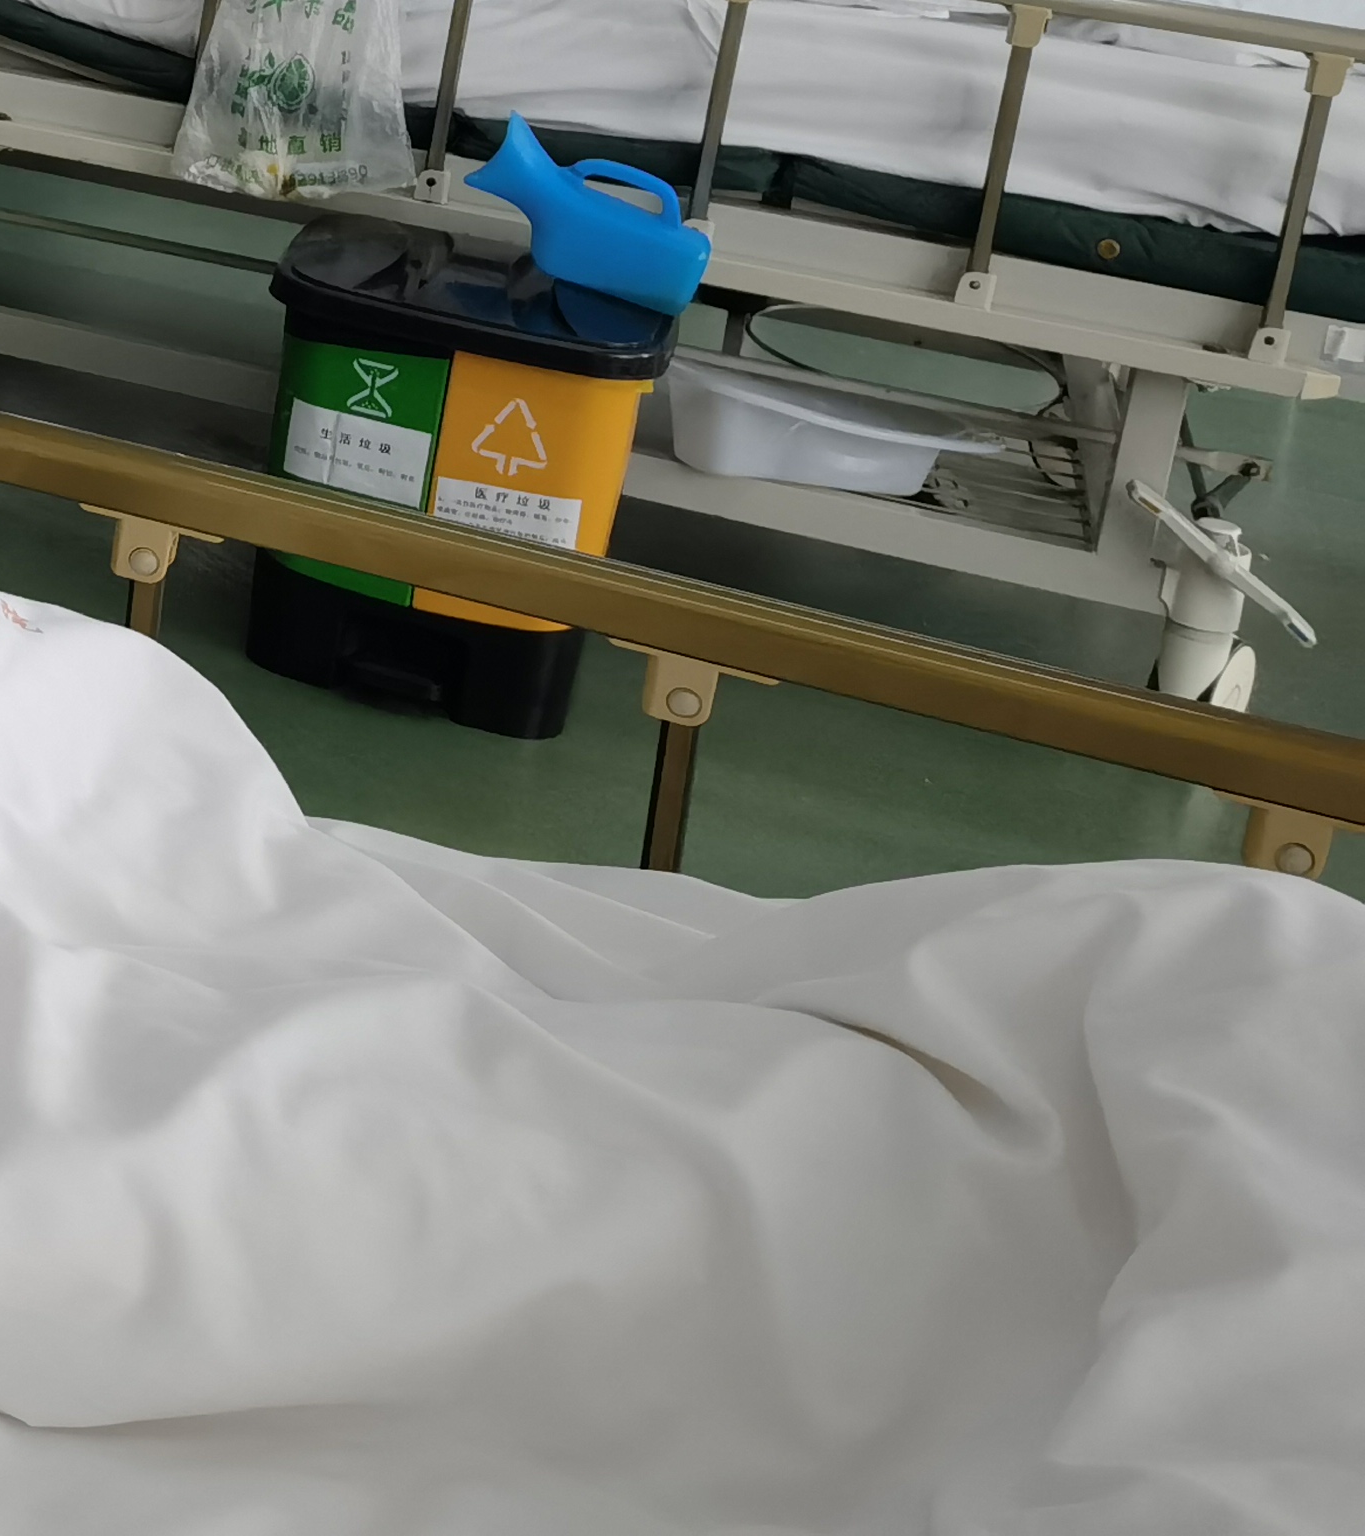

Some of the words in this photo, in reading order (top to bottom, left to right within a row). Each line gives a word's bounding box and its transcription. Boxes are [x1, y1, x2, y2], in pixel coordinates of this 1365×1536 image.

[320, 427, 392, 455] 生活垃圾
[474, 486, 551, 511] 医疗垃圾
